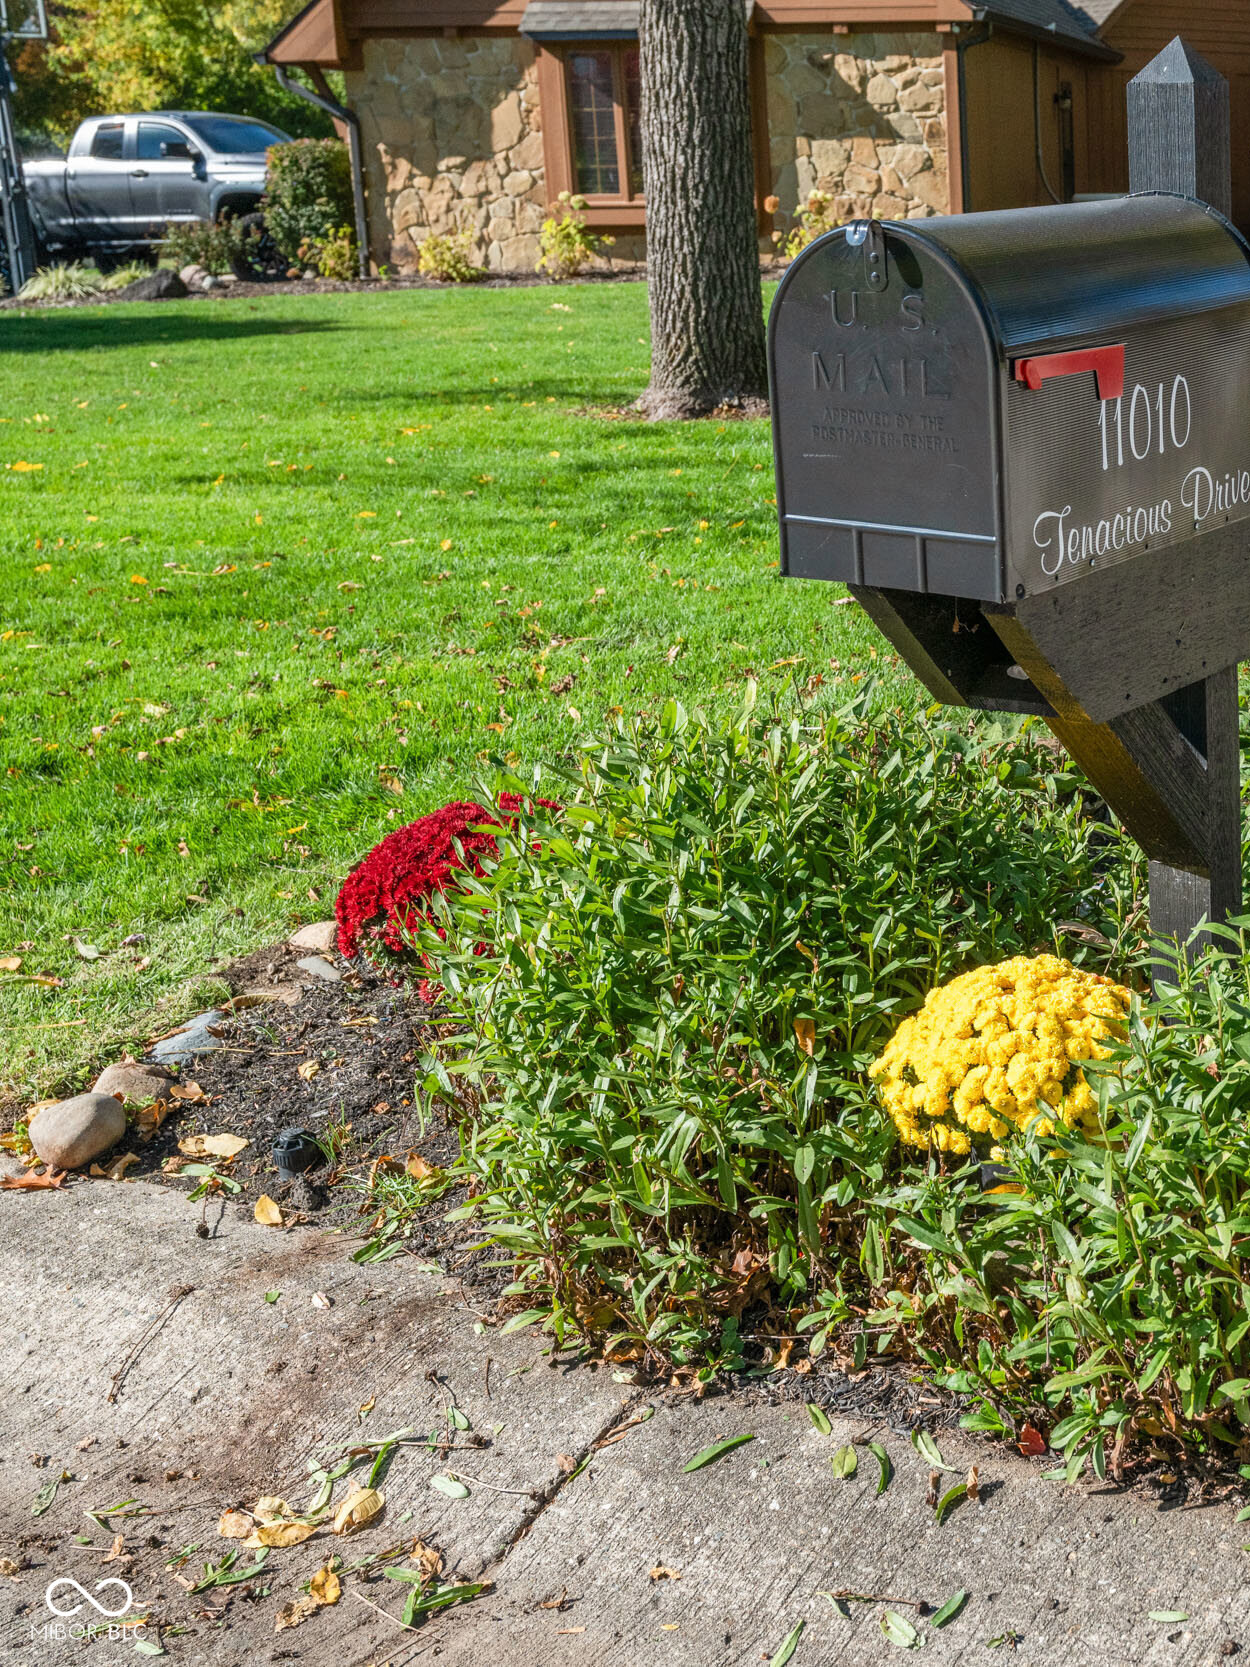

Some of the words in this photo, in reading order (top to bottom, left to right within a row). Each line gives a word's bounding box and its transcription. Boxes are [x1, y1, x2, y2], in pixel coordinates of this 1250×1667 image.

[812, 351, 950, 400] MAIL
[824, 406, 889, 427] APPROVED
[896, 412, 912, 429] BY
[920, 414, 944, 432] THE
[902, 432, 959, 453] GENERAL
[1098, 374, 1191, 470] 11010
[1033, 504, 1172, 575] Tenacious
[1181, 466, 1250, 521] Drive
